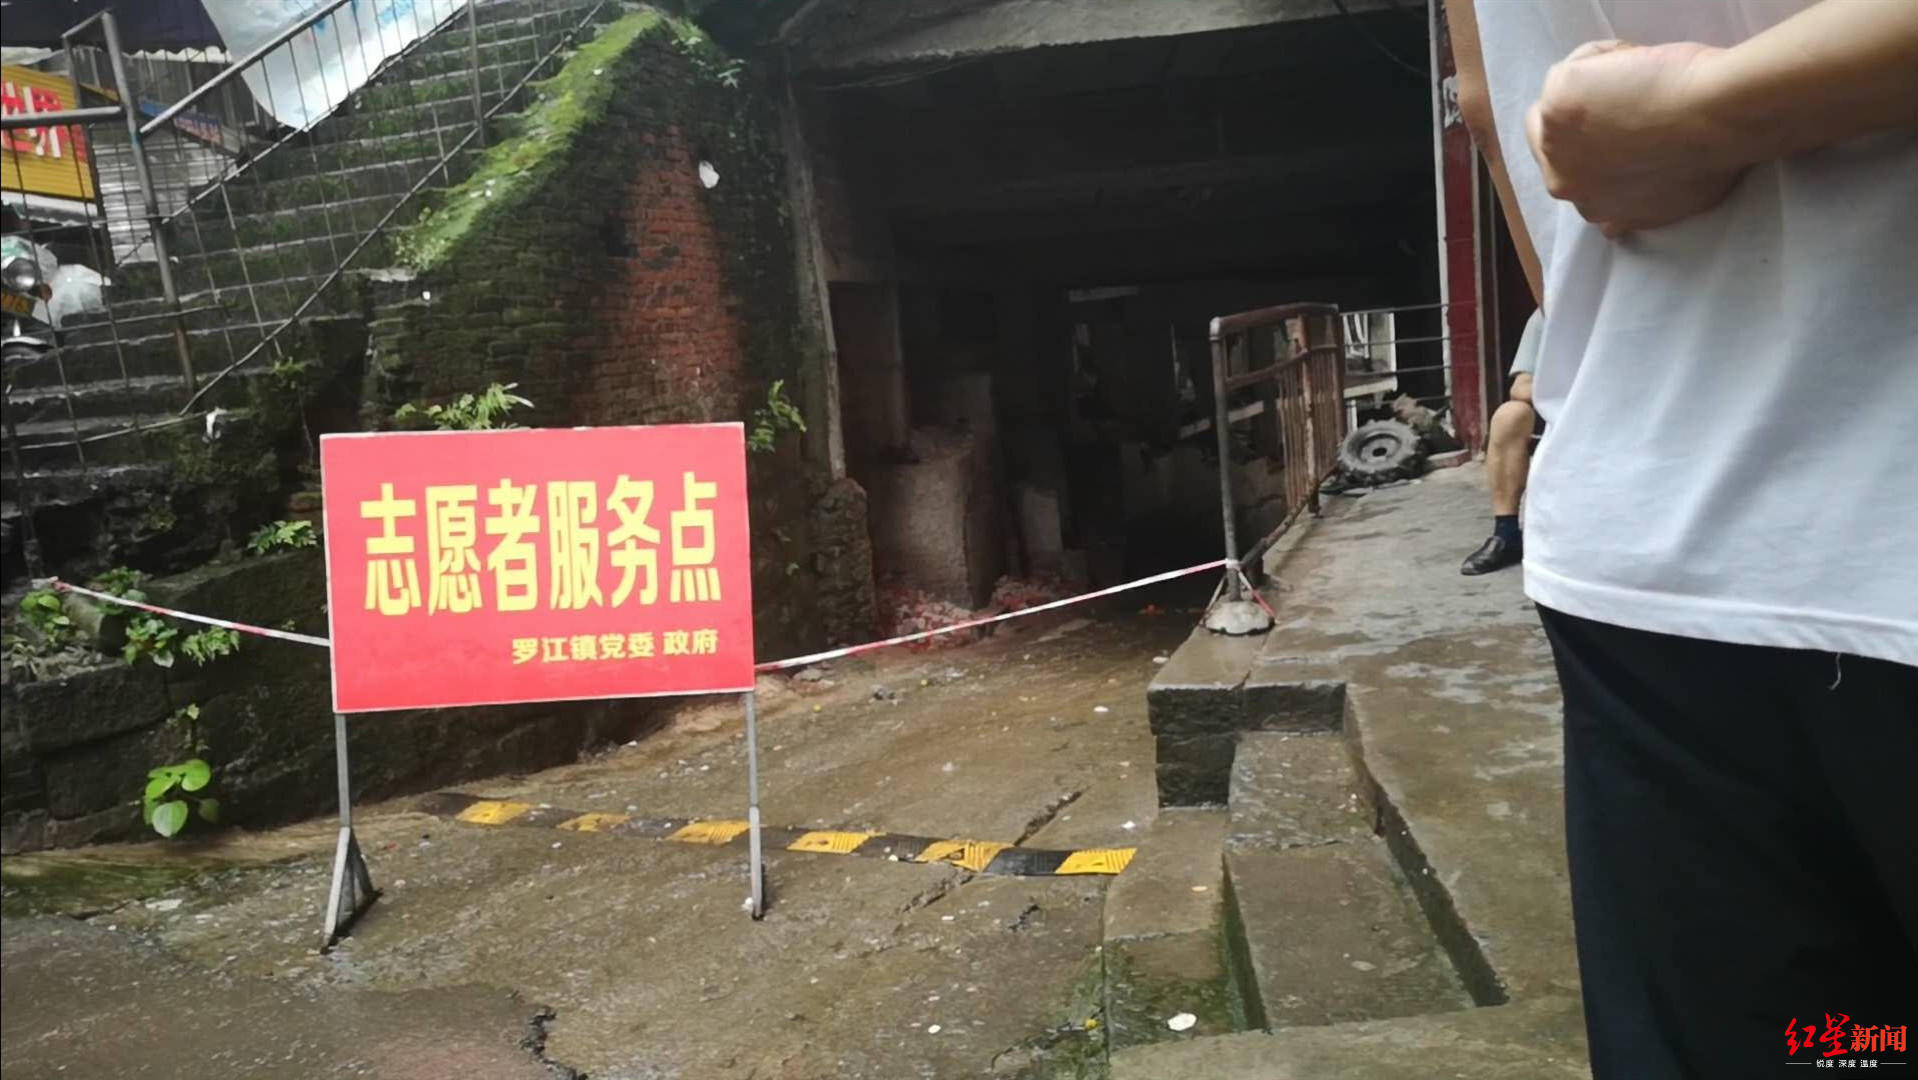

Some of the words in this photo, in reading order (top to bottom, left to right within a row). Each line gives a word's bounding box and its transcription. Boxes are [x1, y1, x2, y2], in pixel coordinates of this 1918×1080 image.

[360, 471, 722, 616] 志愿者服务点
[511, 632, 655, 665] 罗江镇党委
[663, 629, 718, 657] 政府
